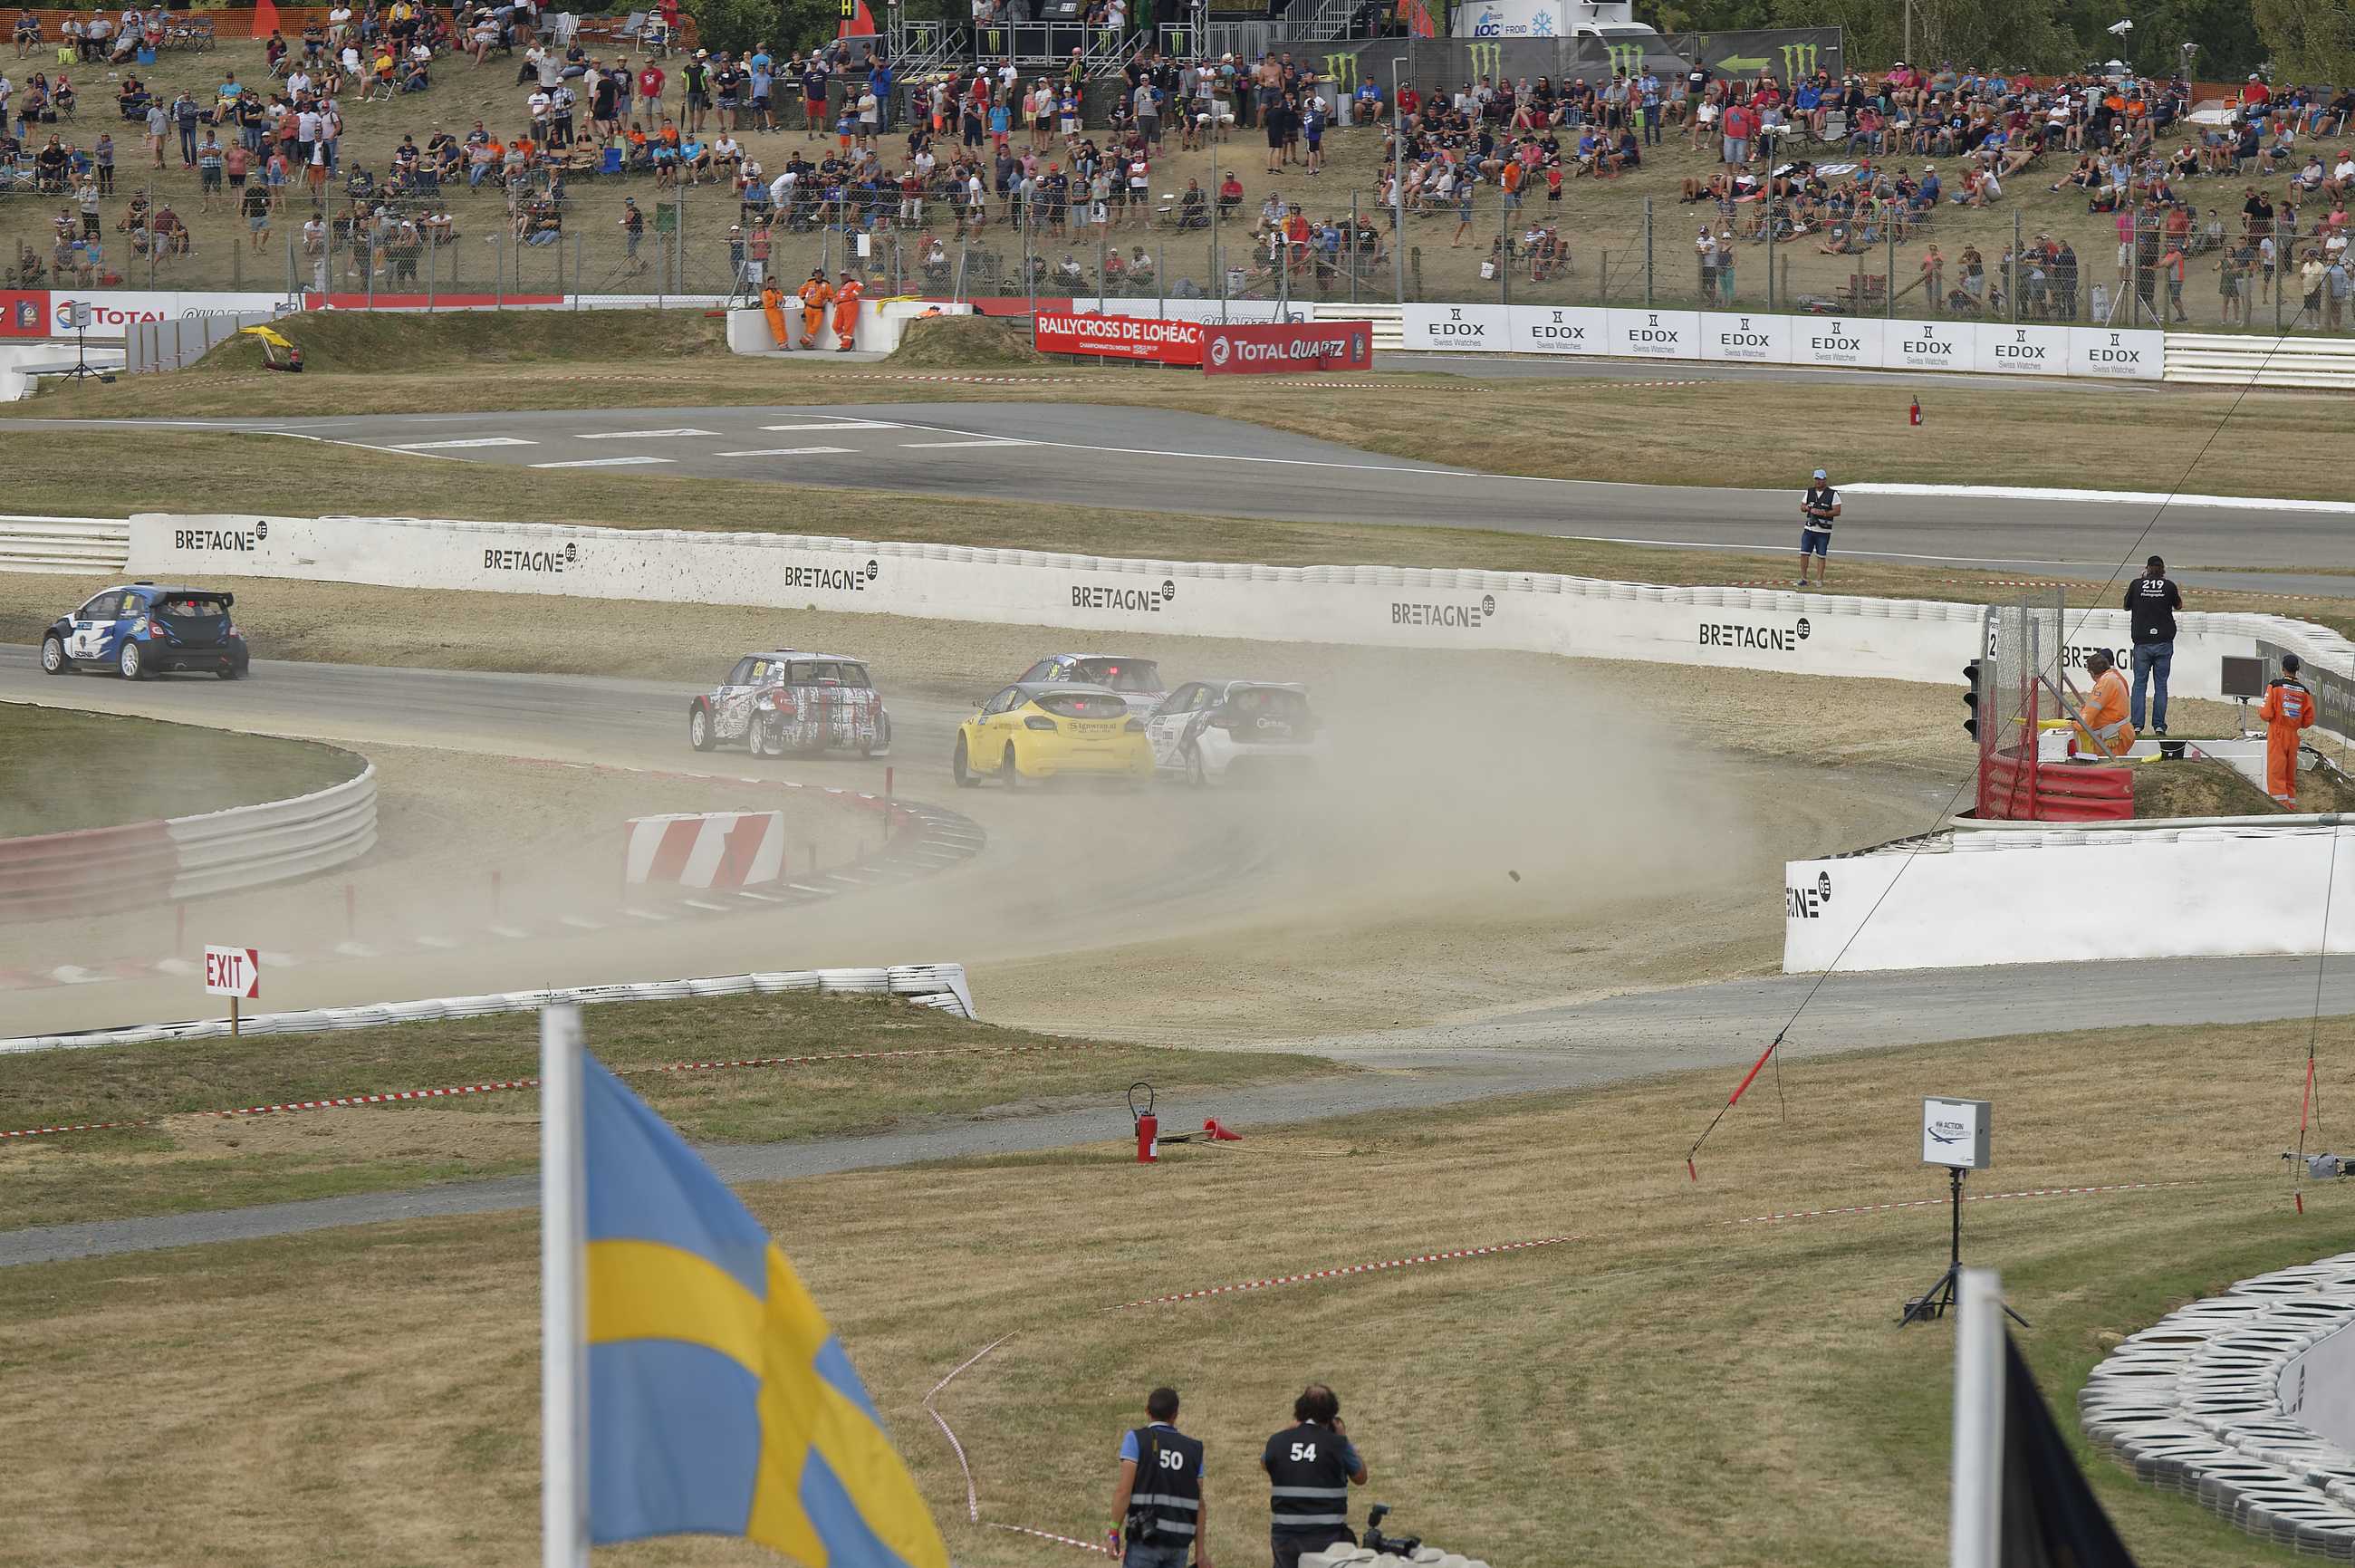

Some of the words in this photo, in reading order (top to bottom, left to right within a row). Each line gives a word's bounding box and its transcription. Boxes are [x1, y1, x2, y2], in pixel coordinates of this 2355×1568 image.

[1474, 24, 1500, 37] LOC
[1505, 25, 1527, 34] FROID
[1039, 317, 1120, 339] RALLYCROSS
[1123, 322, 1141, 340] DE
[1144, 323, 1197, 344] LOHÉAC
[1428, 323, 1485, 336] EDOX
[1532, 326, 1585, 339] EDOX
[1629, 329, 1678, 342] EDOX
[1434, 338, 1453, 347] Swiss
[1454, 339, 1481, 348] Watches
[1537, 340, 1554, 350] Swiss
[1555, 341, 1581, 351] Watches
[1721, 333, 1769, 347] EDOX
[1812, 337, 1860, 351] EDOX
[1234, 340, 1289, 361] TOTAL
[1289, 340, 1346, 360] QUARTZ
[1633, 344, 1649, 353] Swiss
[1650, 345, 1675, 354] Watches
[1725, 348, 1741, 357] Swiss
[1742, 350, 1766, 358] Watches
[1903, 341, 1953, 354] EDOX
[1995, 345, 2045, 359] EDOX
[1815, 352, 1831, 361] Swiss
[1832, 353, 1857, 362] Watches
[1907, 356, 1924, 365] Swiss
[1924, 358, 1949, 366] Watches
[2090, 349, 2139, 363] EDOX
[1998, 360, 2015, 369] Swiss
[2016, 361, 2041, 370] Watches
[2093, 364, 2110, 373] Swiss
[2110, 366, 2136, 375] Watches
[175, 530, 254, 551] BRETAGNE
[485, 550, 563, 572] BRETAGNE
[785, 567, 864, 591] BRETAGNE
[2142, 580, 2165, 589] 219
[1072, 586, 1160, 611] BRETAGNE
[1391, 602, 1481, 628] BRETAGNE
[1699, 624, 1795, 650] BRETAGNE
[1989, 633, 1996, 657] 2
[206, 953, 243, 989] EXIT
[1944, 1121, 1965, 1130] ACTION
[1158, 1448, 1184, 1471] 50
[1290, 1442, 1318, 1463] 54
